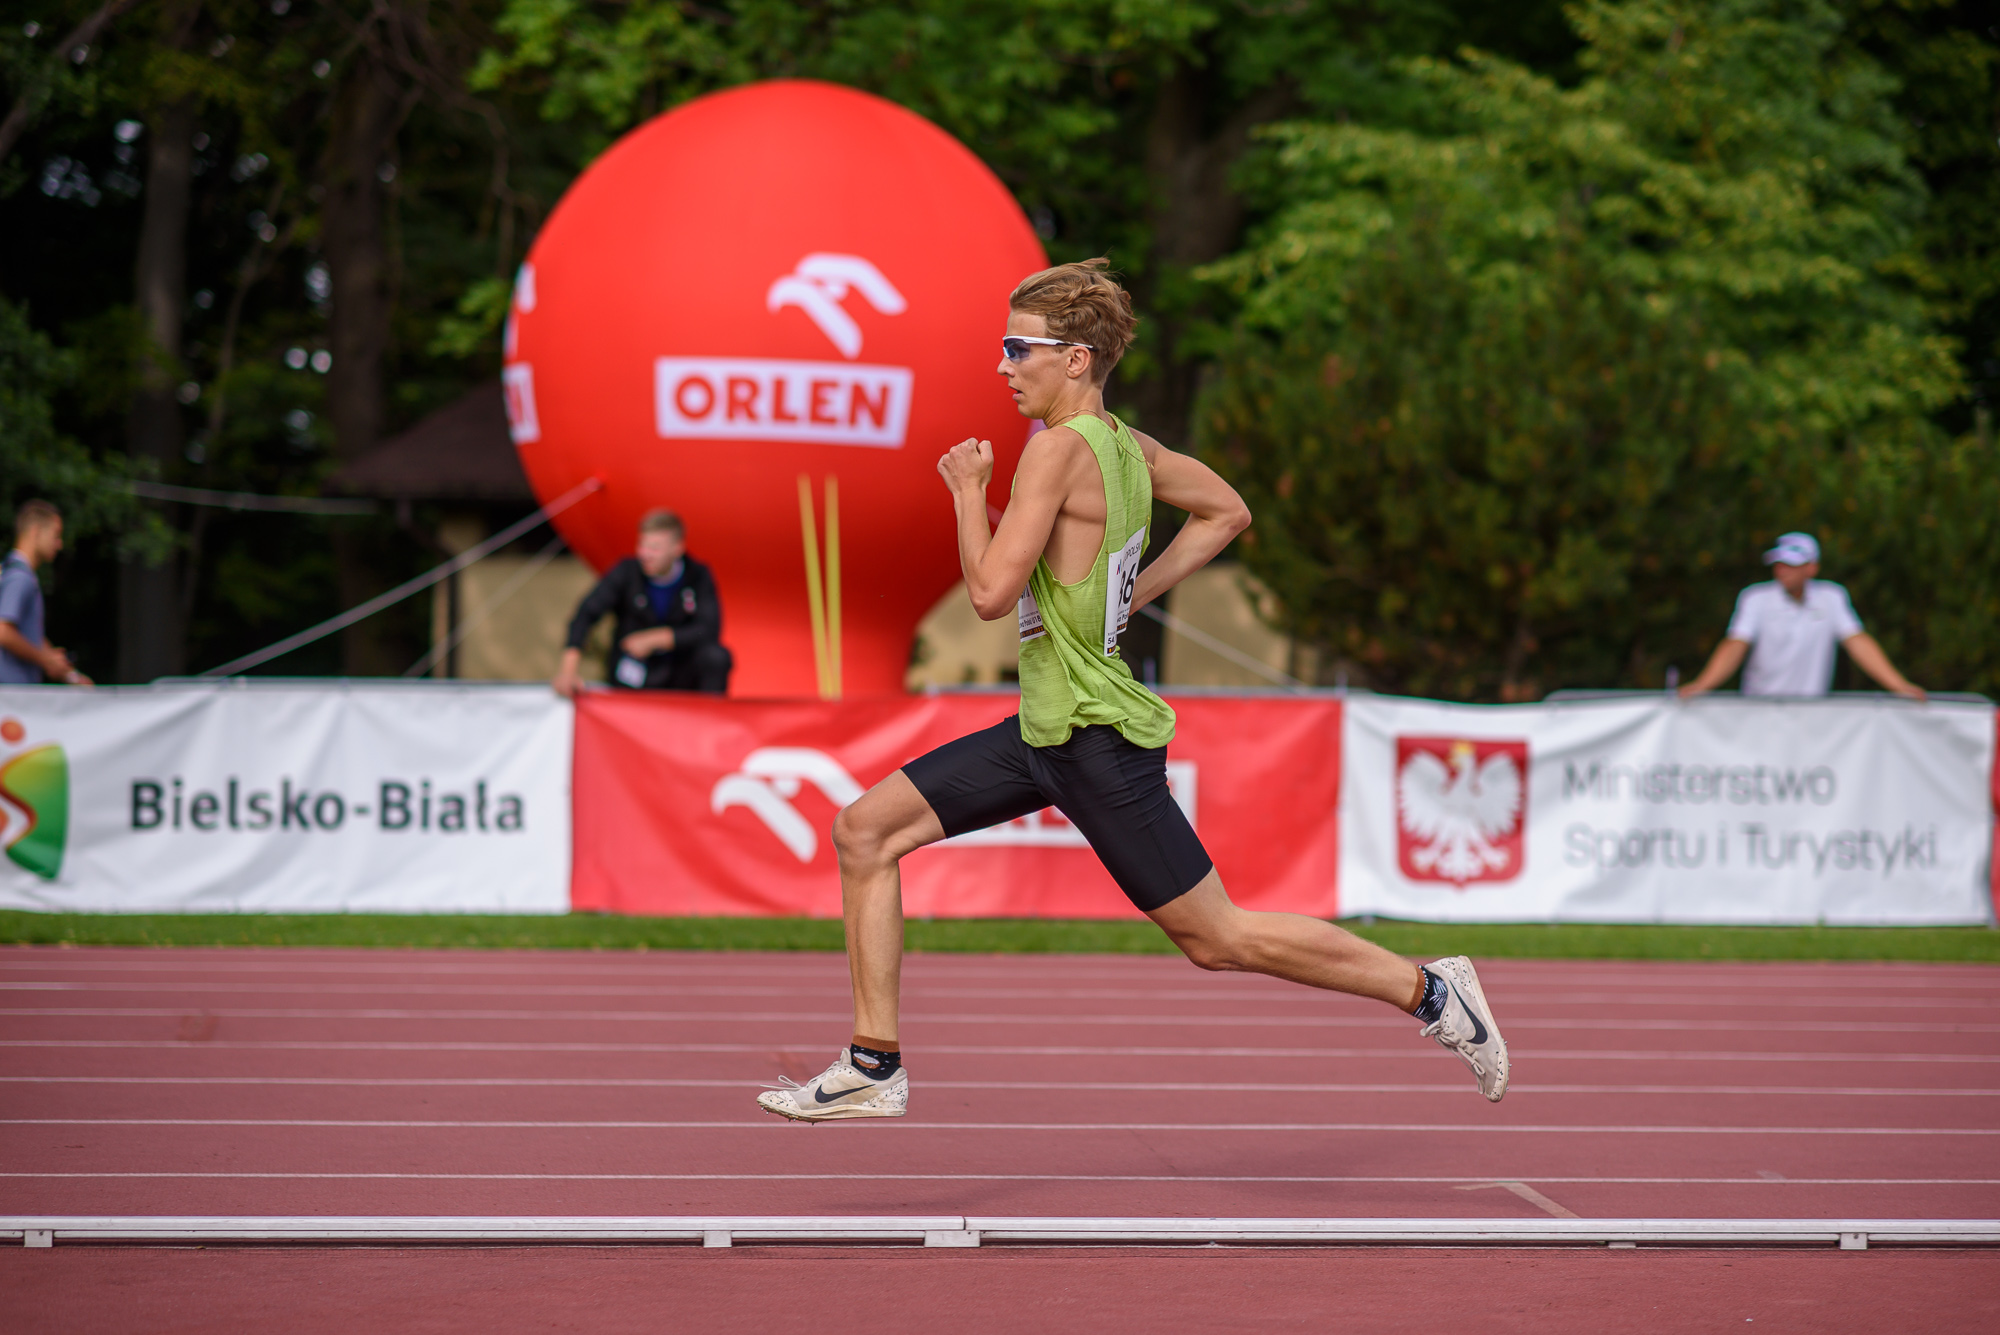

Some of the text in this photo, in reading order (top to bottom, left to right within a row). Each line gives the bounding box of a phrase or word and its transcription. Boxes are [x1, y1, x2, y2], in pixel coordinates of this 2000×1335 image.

[674, 375, 889, 429] ORLEN
[130, 777, 526, 832] Bielsko-Biała
[1562, 760, 1837, 806] Ministerstwo
[1563, 822, 1940, 879] Sportu i Turystyki
